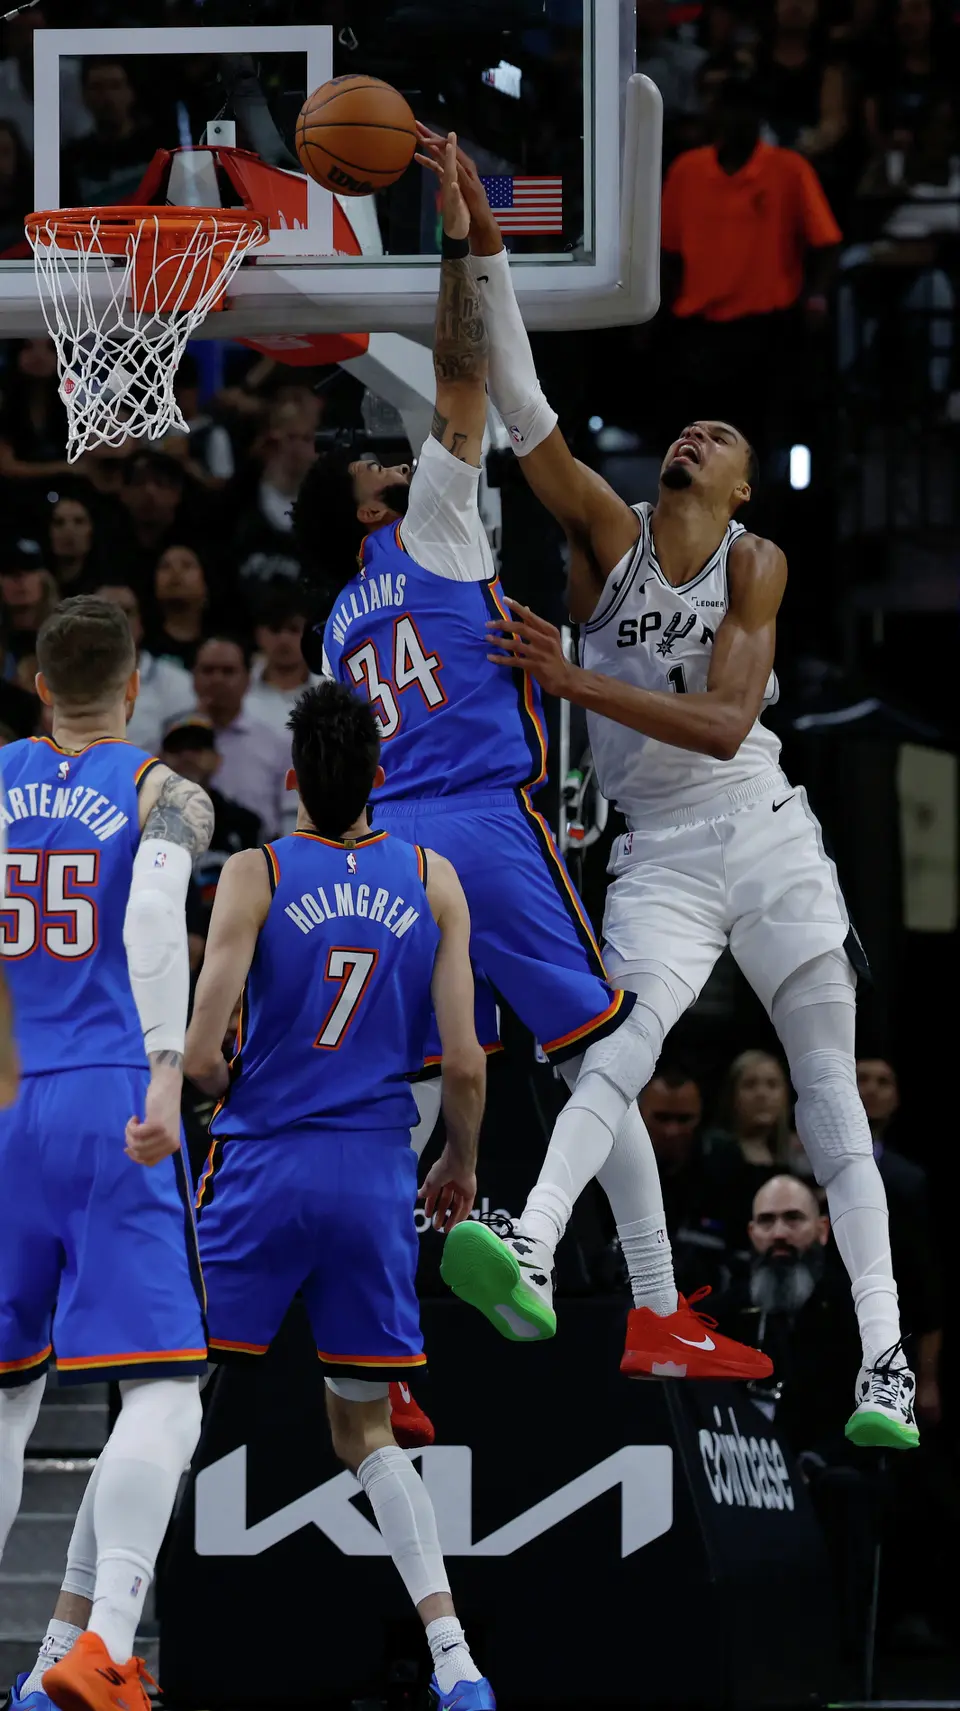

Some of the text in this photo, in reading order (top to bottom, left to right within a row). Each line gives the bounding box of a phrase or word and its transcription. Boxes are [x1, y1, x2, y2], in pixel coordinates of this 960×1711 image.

[332, 572, 407, 646] WILLIAMS
[695, 600, 725, 608] LEDGER
[342, 611, 449, 742] 34
[0, 848, 101, 964] 55
[283, 882, 420, 939] HOLMGREN
[312, 945, 380, 1051] 7
[698, 1404, 795, 1512] coinbase
